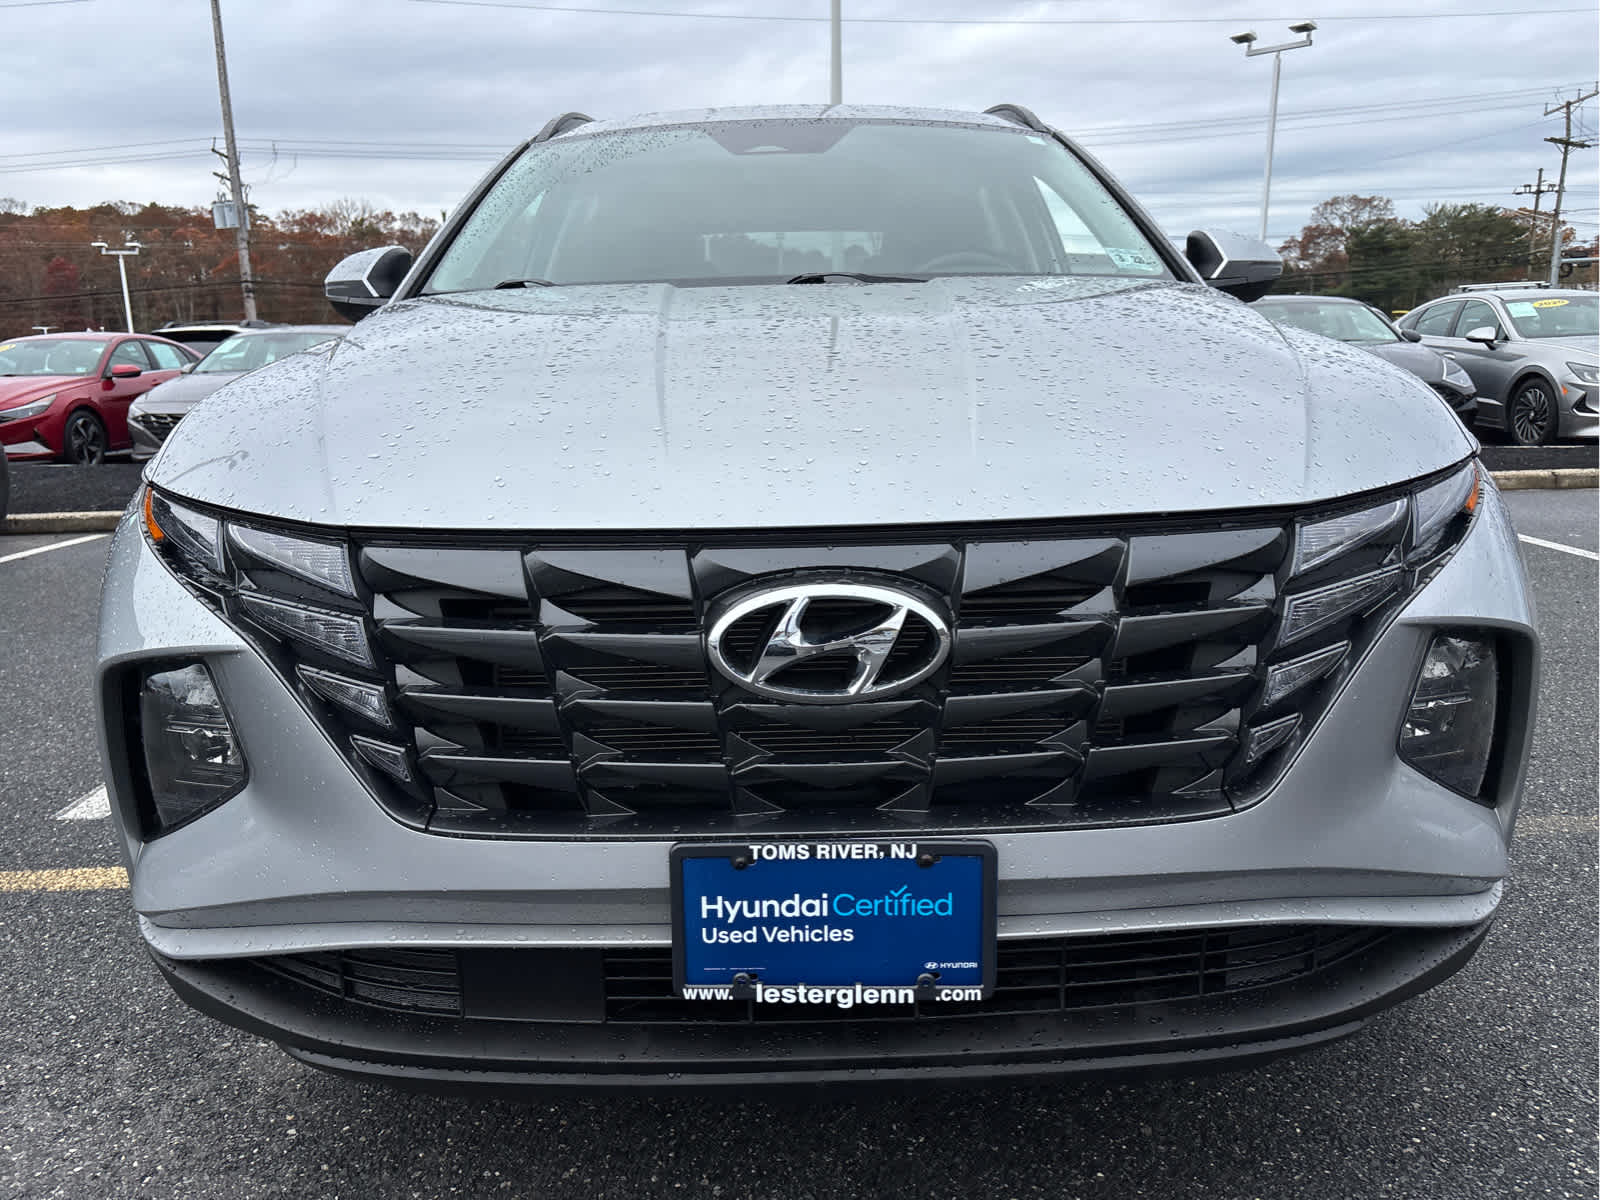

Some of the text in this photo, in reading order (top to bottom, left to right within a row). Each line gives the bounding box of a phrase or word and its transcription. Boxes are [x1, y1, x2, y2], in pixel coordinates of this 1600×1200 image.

[749, 843, 918, 860] TOMS RIVER, NJ
[700, 885, 953, 923] Hyundai Certified
[701, 925, 854, 943] Used Vehicles
[683, 984, 982, 1009] www. lesterglenn .com
